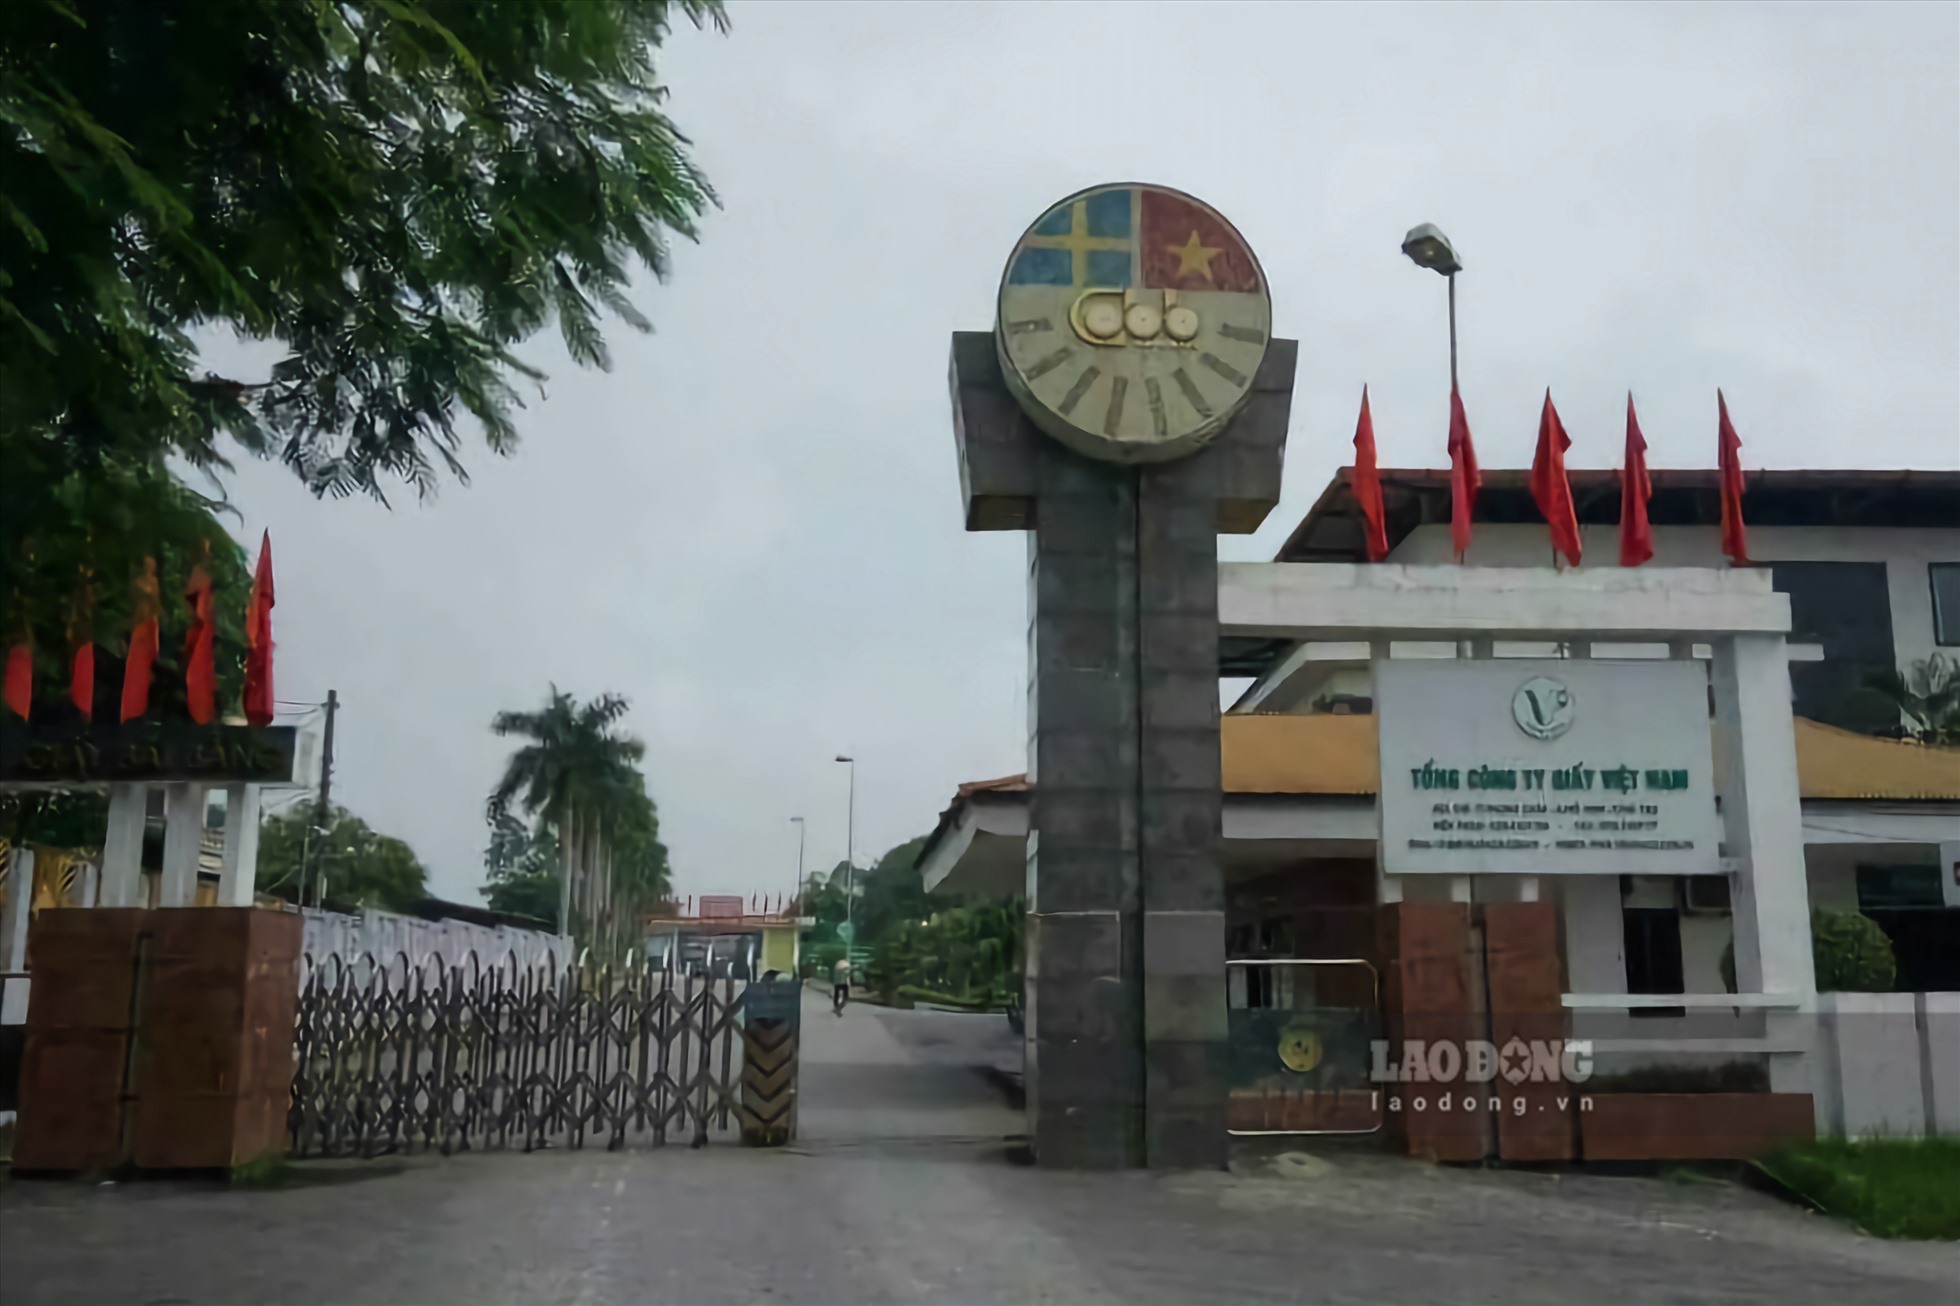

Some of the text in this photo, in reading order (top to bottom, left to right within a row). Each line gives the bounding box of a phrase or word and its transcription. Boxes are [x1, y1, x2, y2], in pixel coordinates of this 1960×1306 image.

[1522, 769, 1545, 790] TY
[1600, 763, 1640, 794] VIỆT
[1645, 769, 1689, 790] NAM
